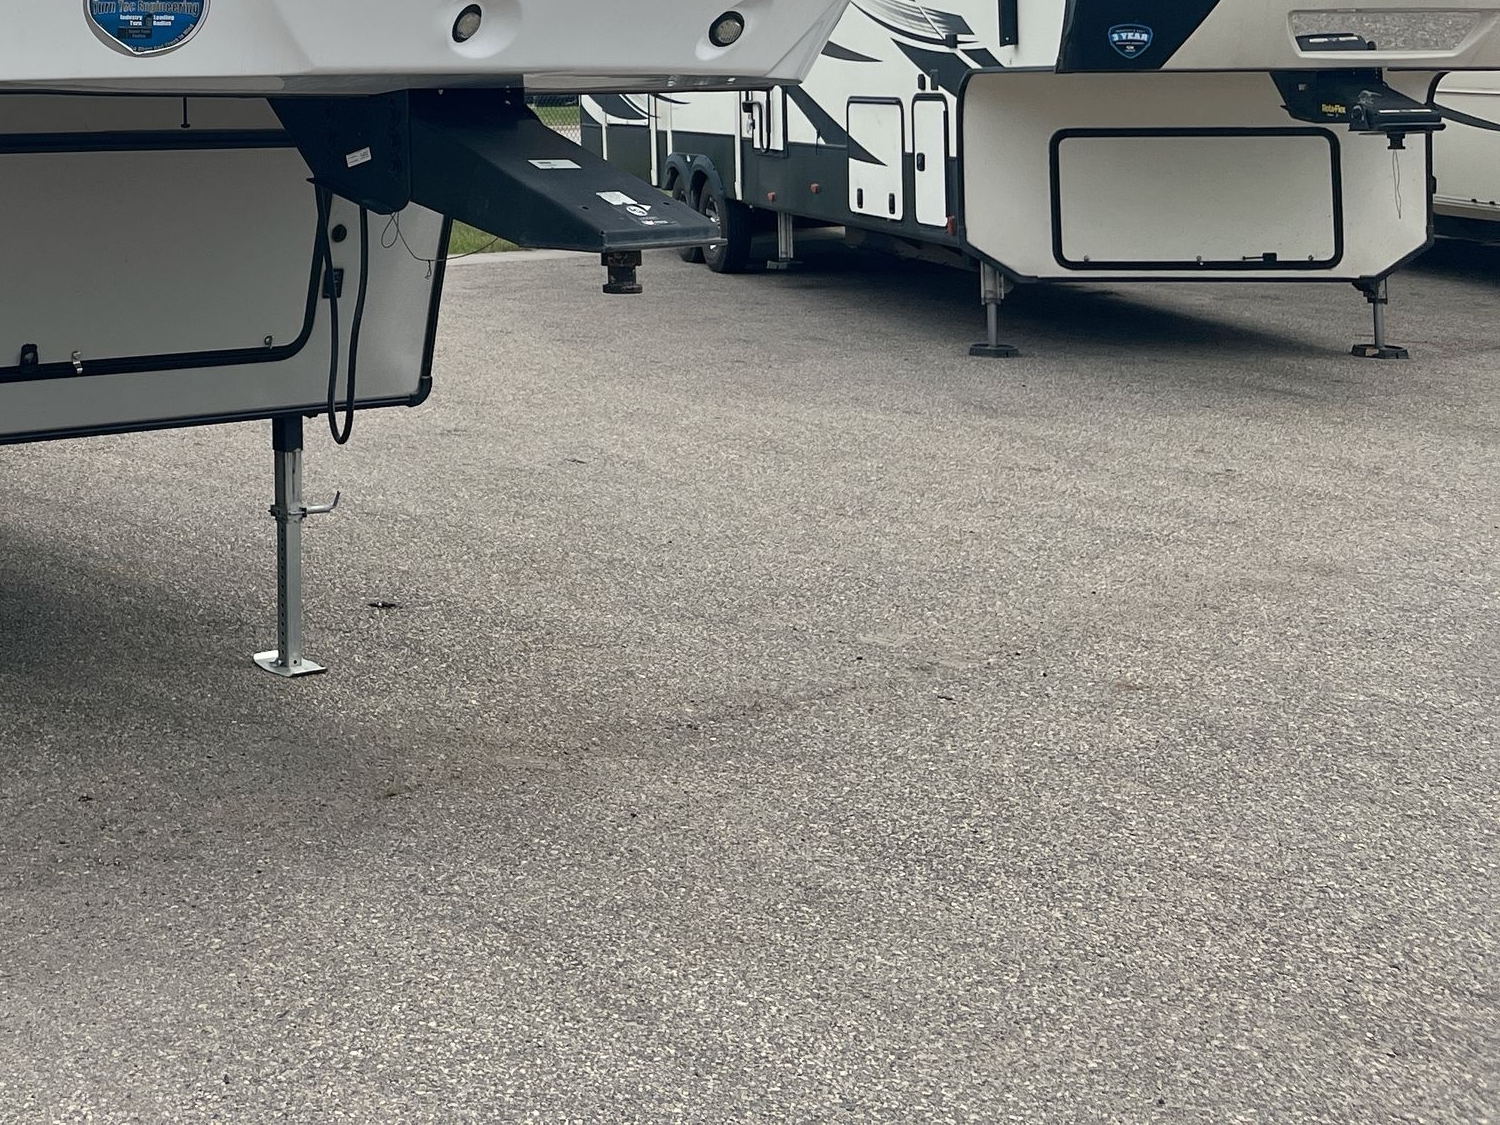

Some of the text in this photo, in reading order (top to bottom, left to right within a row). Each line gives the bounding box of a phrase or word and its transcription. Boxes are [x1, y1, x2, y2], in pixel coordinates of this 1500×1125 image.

[92, 0, 199, 17] Turn Tec Engineering
[1120, 32, 1148, 42] YEAR
